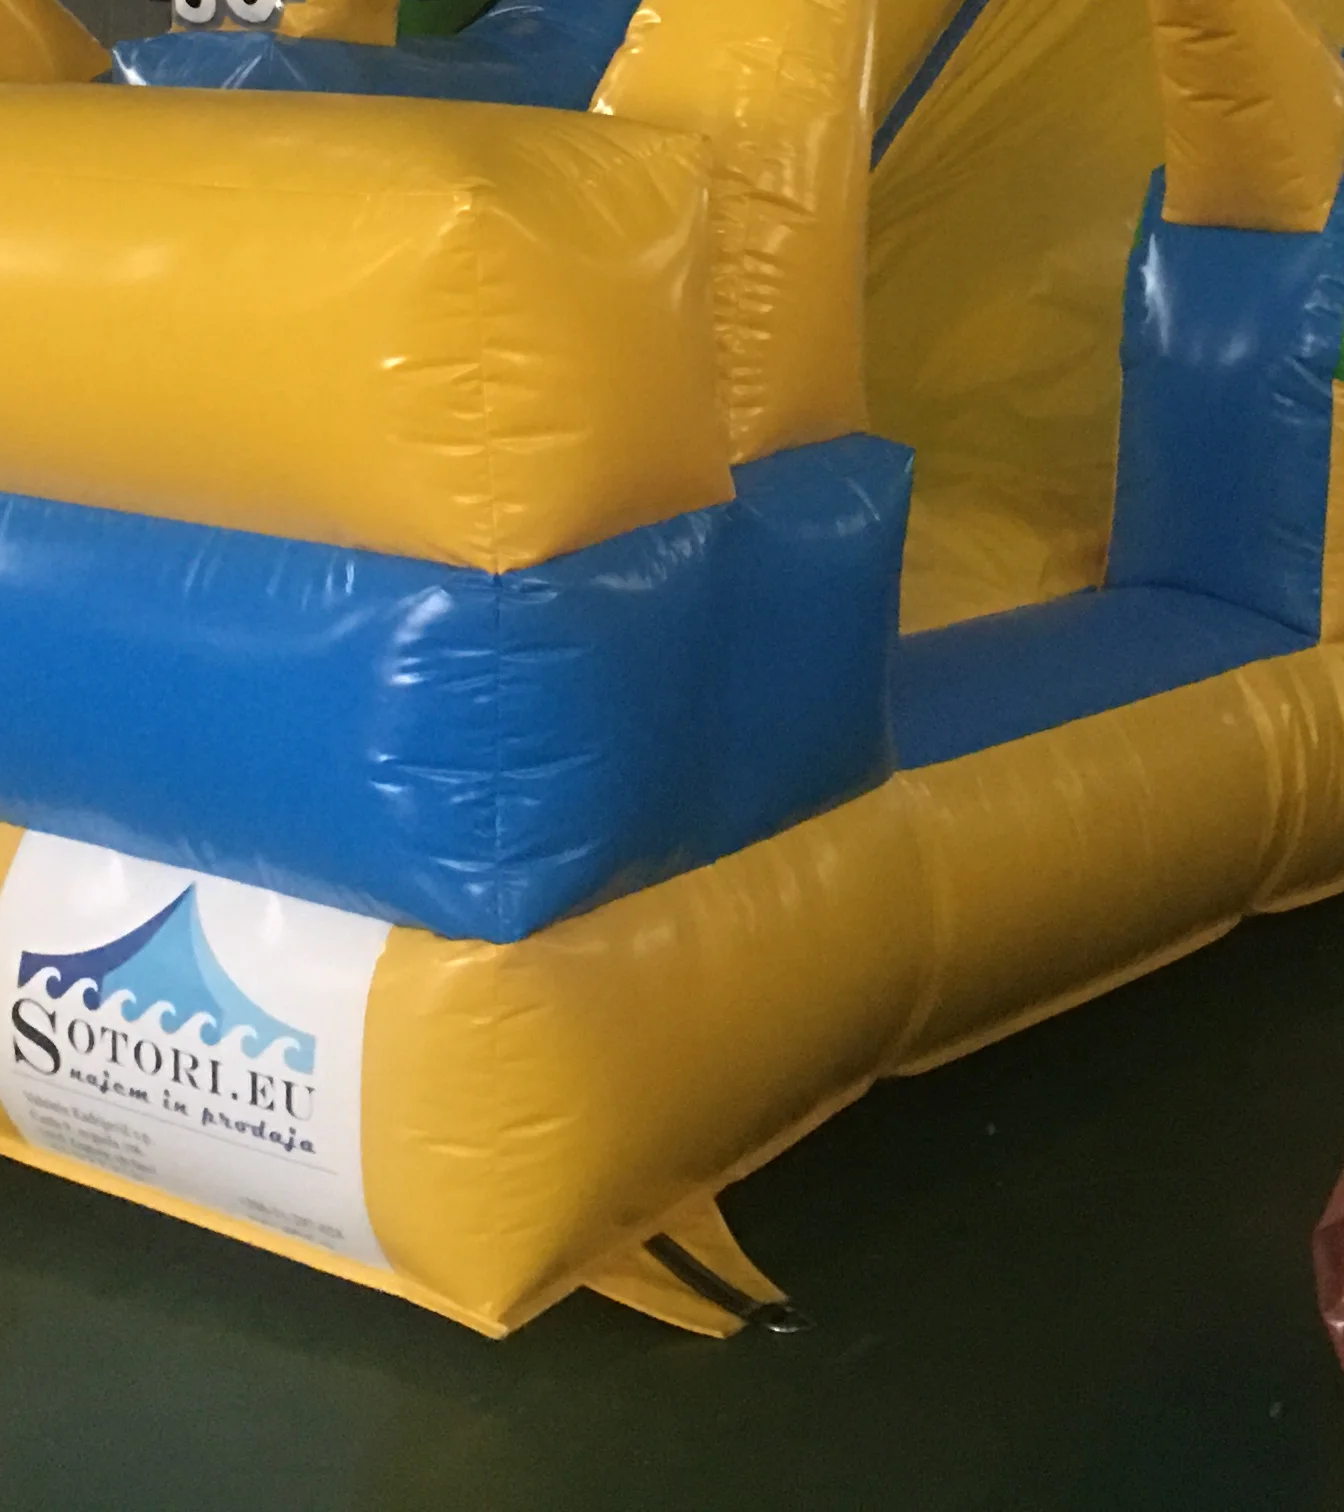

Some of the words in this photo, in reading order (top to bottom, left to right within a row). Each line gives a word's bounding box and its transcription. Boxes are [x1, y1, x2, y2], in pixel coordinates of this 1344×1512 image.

[11, 997, 316, 1122] SOTORI.EU
[70, 1067, 150, 1103] najem
[163, 1089, 189, 1116] in
[201, 1107, 316, 1154] prodaja
